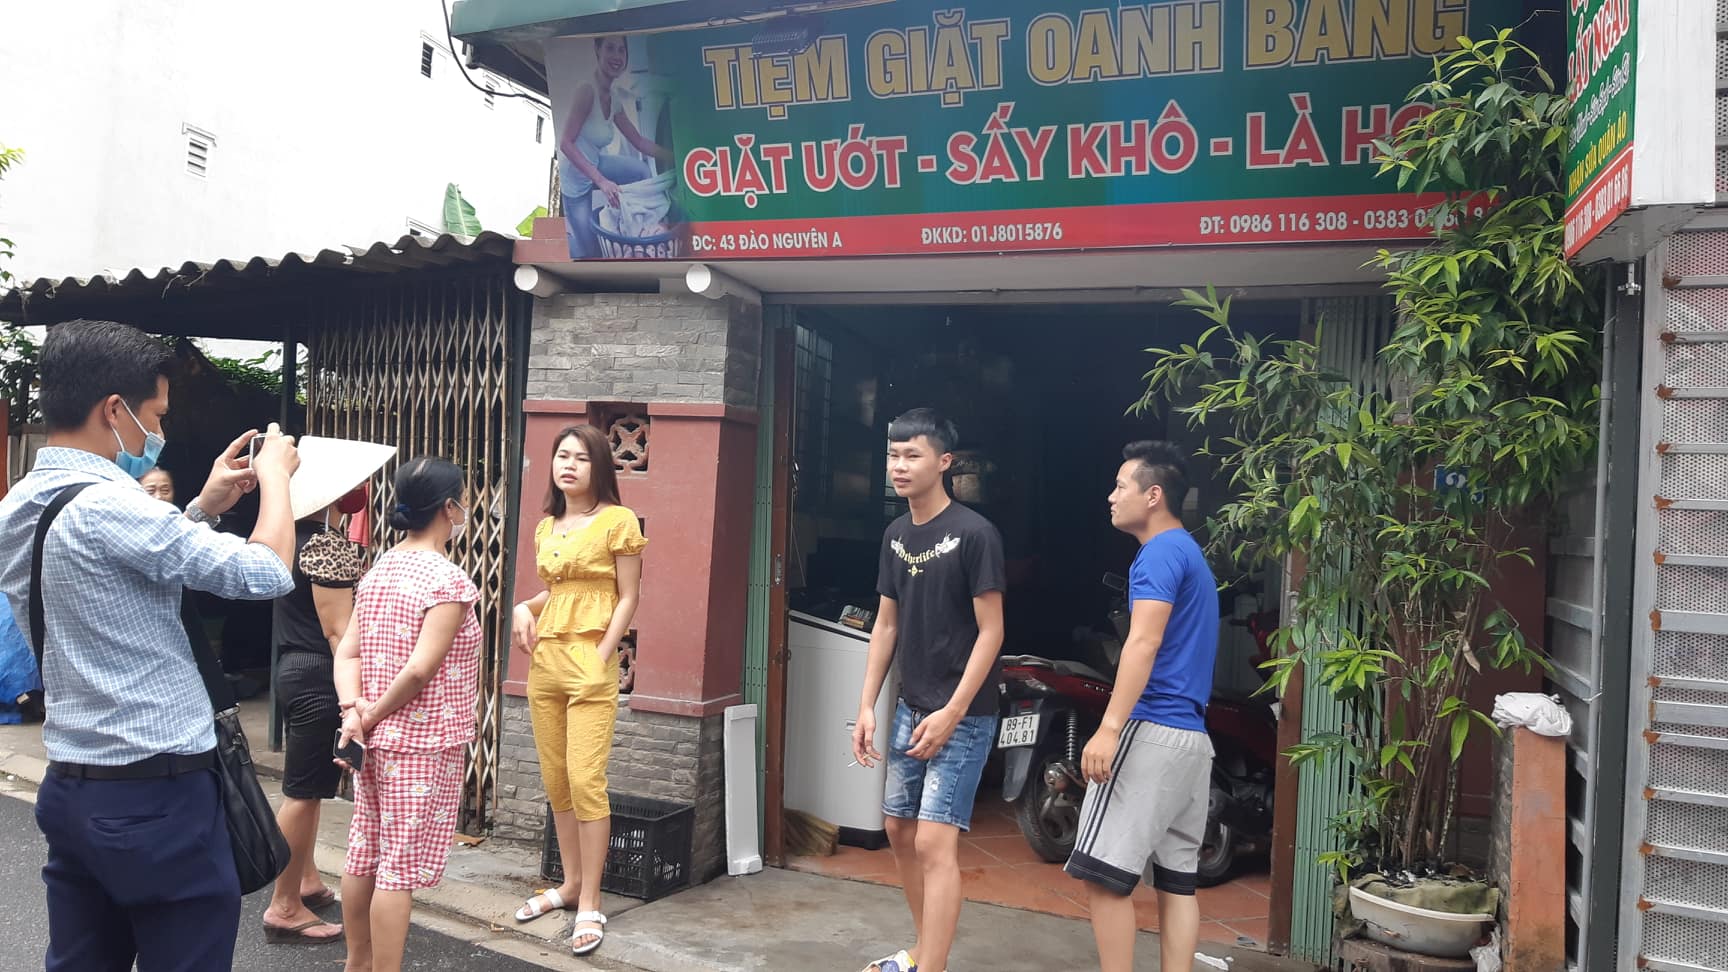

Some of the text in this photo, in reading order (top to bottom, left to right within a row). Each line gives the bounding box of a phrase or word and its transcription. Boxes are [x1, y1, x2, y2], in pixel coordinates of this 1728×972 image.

[864, 8, 1011, 108] GIẶT
[1026, 0, 1224, 86] OANH
[683, 134, 793, 208] GIẶT
[801, 123, 907, 192] ƯỚT
[917, 155, 937, 172] -
[945, 101, 1058, 185] SẤY
[1067, 99, 1198, 179] KHÔ
[1210, 137, 1232, 156] -
[1246, 92, 1329, 169] LÀ
[921, 222, 1063, 244] ĐKKD: 01J8015876
[1200, 216, 1225, 234] ĐT:
[1230, 214, 1272, 233] 0986
[1278, 213, 1310, 231] 116
[1315, 212, 1347, 231] 308
[1364, 210, 1409, 229] 0383
[692, 228, 842, 250] ĐC: 43 ĐÀO NGUYÊN A
[1006, 716, 1033, 731] 89-F1
[1000, 730, 1035, 745] 404.81
